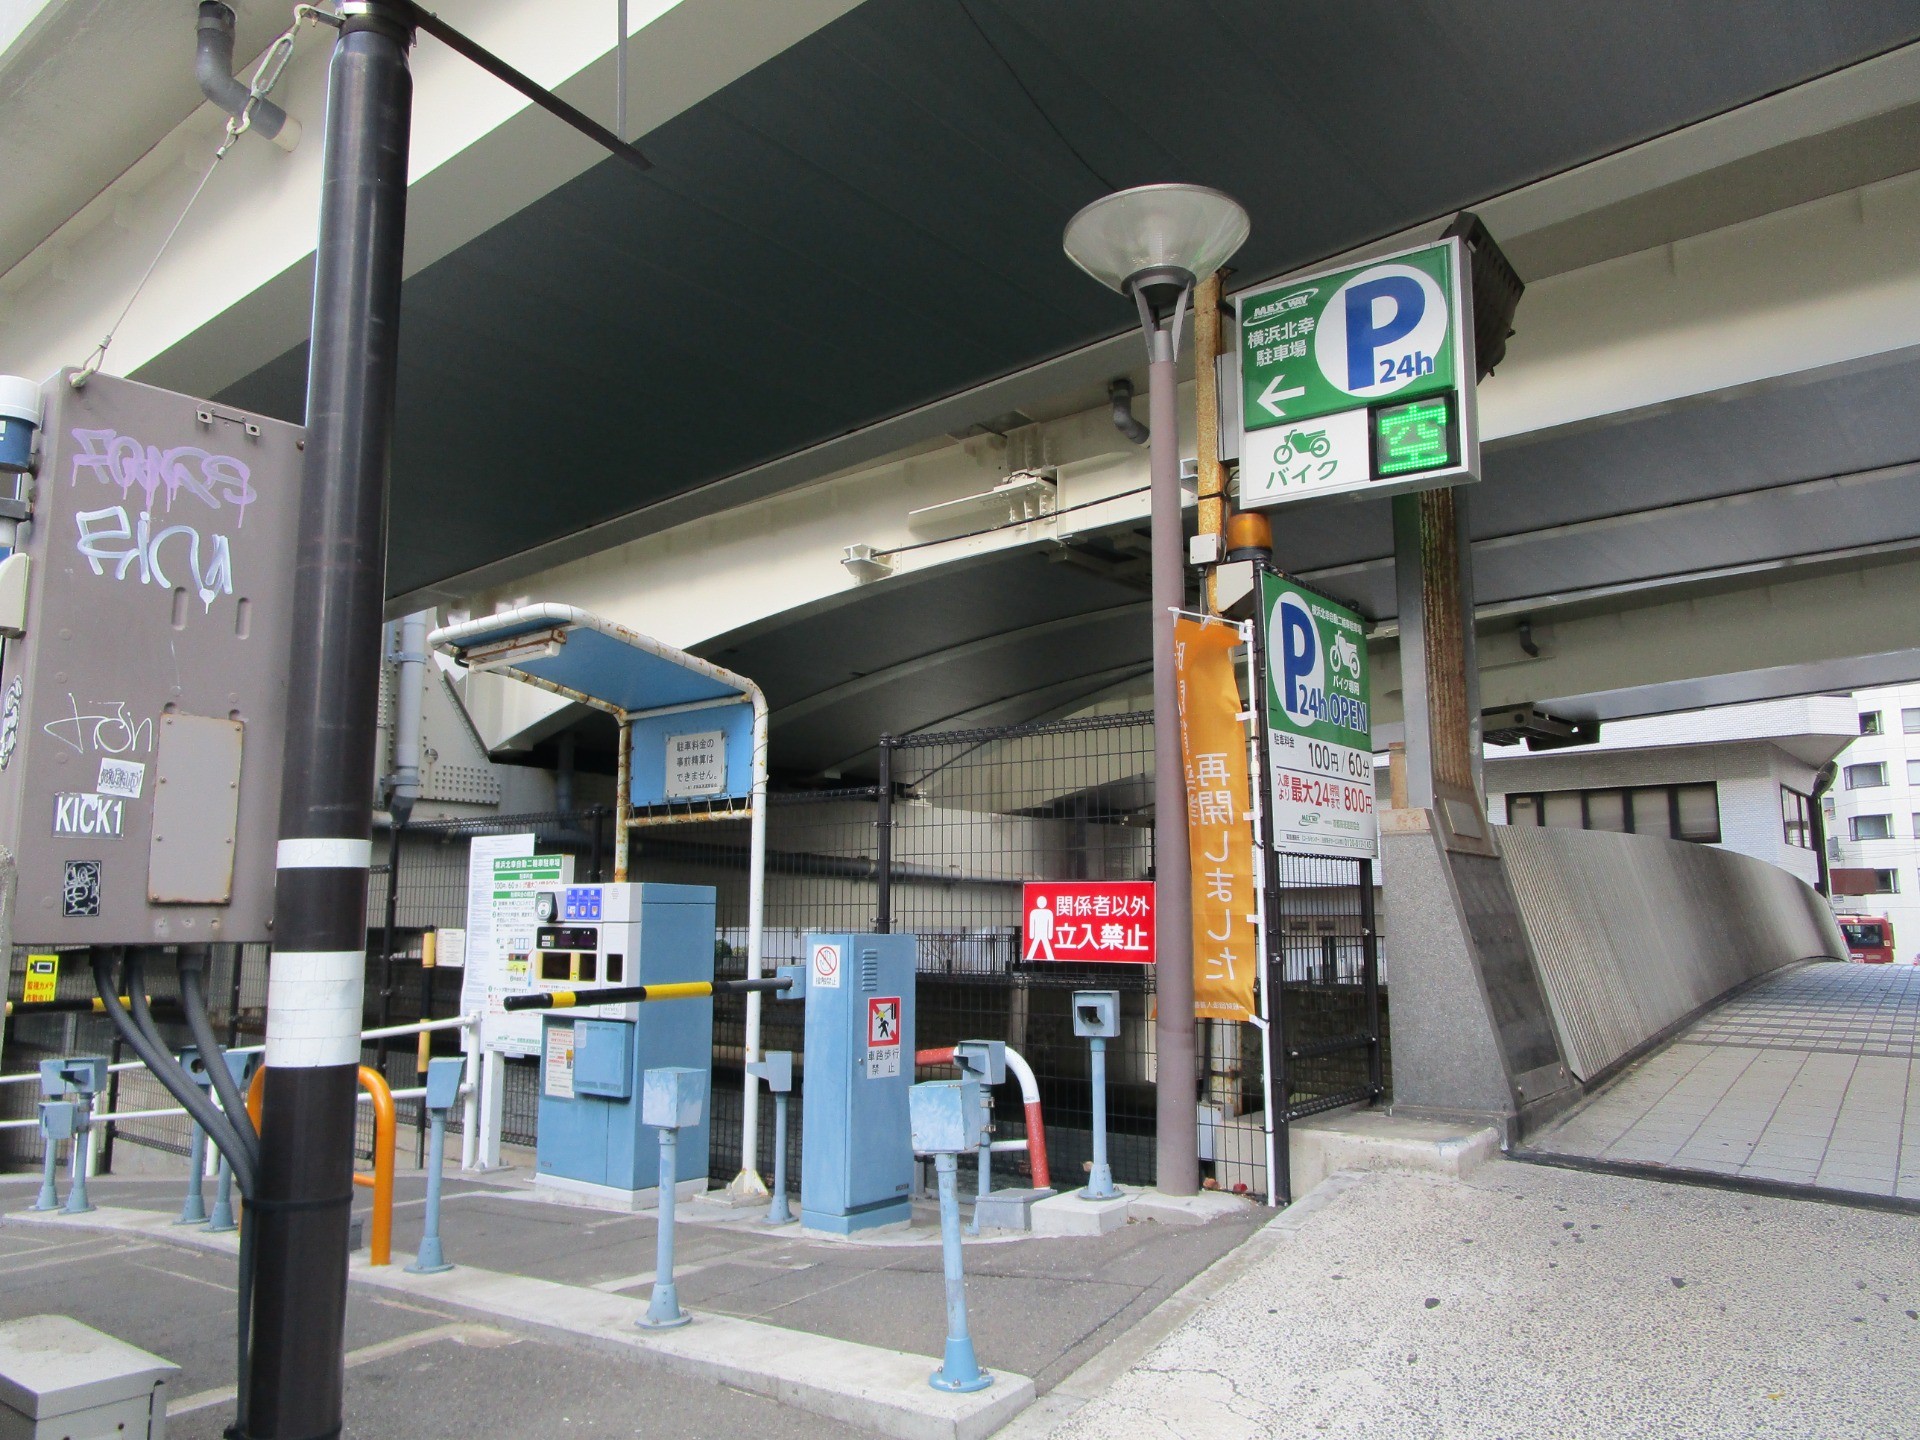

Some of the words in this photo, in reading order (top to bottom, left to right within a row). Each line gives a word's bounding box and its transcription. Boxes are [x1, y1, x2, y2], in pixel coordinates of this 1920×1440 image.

[1253, 300, 1285, 318] MEX
[1287, 294, 1309, 308] WAY
[1247, 316, 1315, 349] 横浜北幸
[1344, 275, 1426, 391] P
[1256, 339, 1307, 367] 駐車場
[1379, 350, 1434, 384] 24h
[1381, 404, 1448, 473] 空
[1265, 459, 1339, 490] バイク
[1281, 602, 1316, 713] P
[1298, 683, 1329, 722] 24h
[1329, 692, 1368, 734] OPEN
[676, 738, 715, 752] 駐車料金の
[1308, 742, 1339, 772] 100円
[1348, 751, 1370, 778] 60分
[676, 754, 714, 768] 事前精算は
[676, 770, 717, 783] できません。
[55, 796, 122, 834] KICK1
[1344, 786, 1373, 814] 800円
[1056, 895, 1150, 917] 関係者以外
[1054, 922, 1149, 951] 立入禁止
[868, 1049, 899, 1061] 車路歩行
